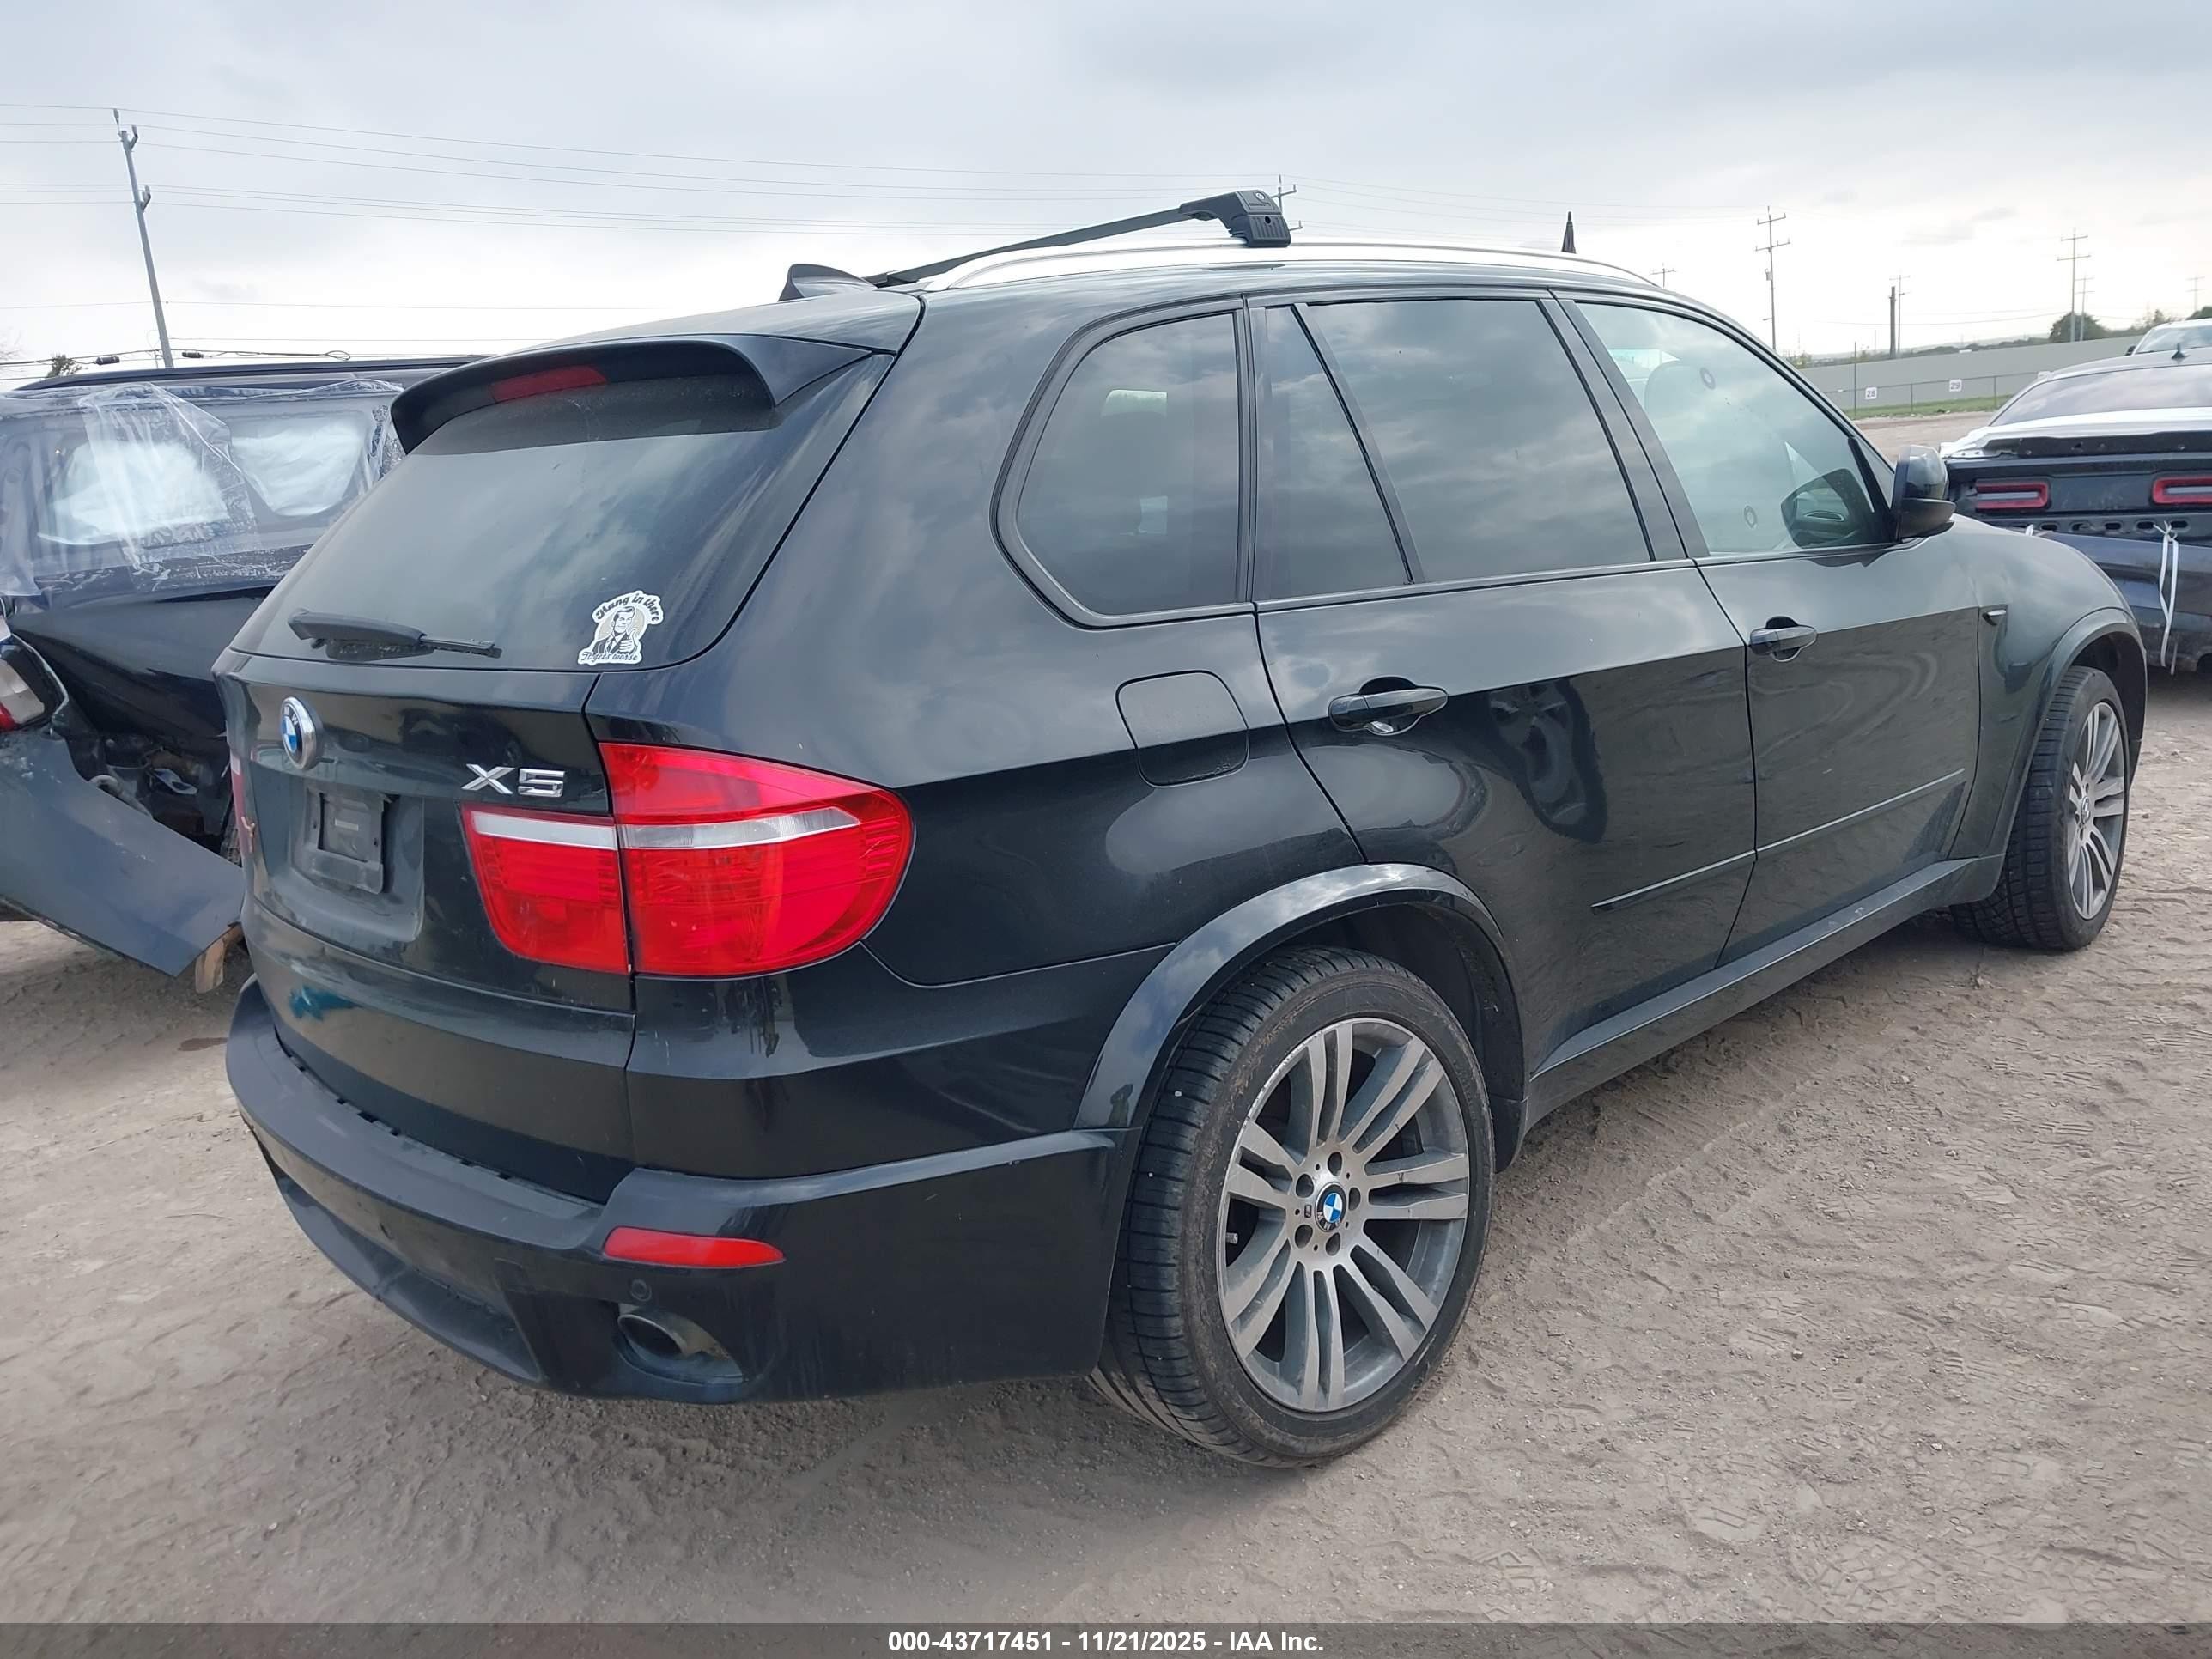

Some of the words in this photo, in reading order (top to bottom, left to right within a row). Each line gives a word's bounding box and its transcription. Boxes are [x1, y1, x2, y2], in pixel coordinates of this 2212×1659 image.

[596, 596, 630, 620] Hang
[631, 592, 644, 604] in
[642, 598, 660, 622] there
[580, 651, 592, 661] It
[592, 652, 611, 663] gets
[611, 653, 639, 661] worse
[461, 763, 565, 798] X5
